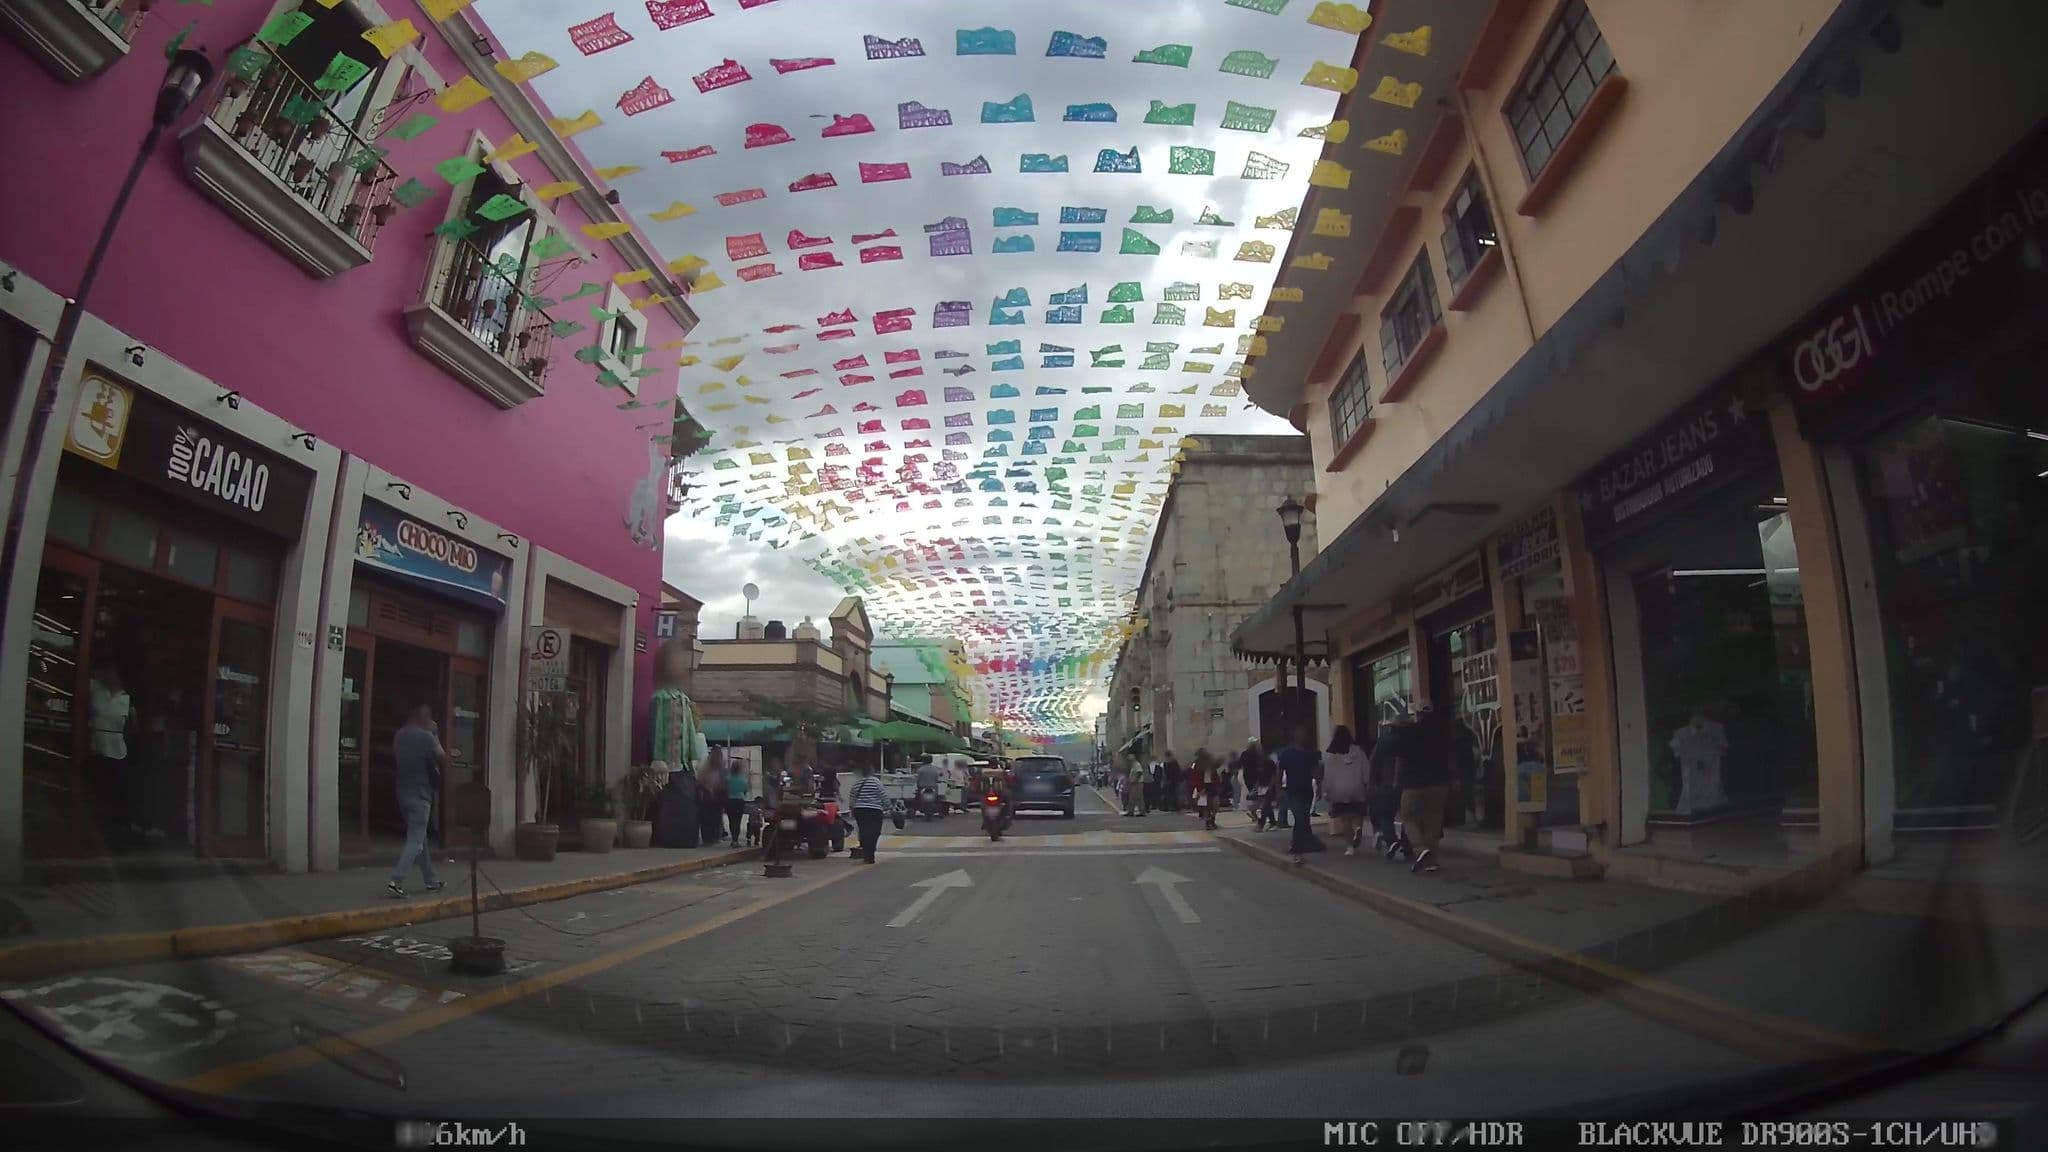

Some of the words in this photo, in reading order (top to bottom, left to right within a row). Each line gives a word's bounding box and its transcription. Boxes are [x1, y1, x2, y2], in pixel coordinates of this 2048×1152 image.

[1880, 248, 1970, 329] Rompe
[1969, 212, 2024, 263] con
[168, 425, 195, 483] 100%
[190, 438, 269, 512] CACAO
[1600, 448, 1660, 497] BAZAR
[1660, 409, 1720, 470] JEANS
[398, 520, 448, 560] CHOCO
[448, 541, 477, 572] MIO
[657, 615, 673, 636] H
